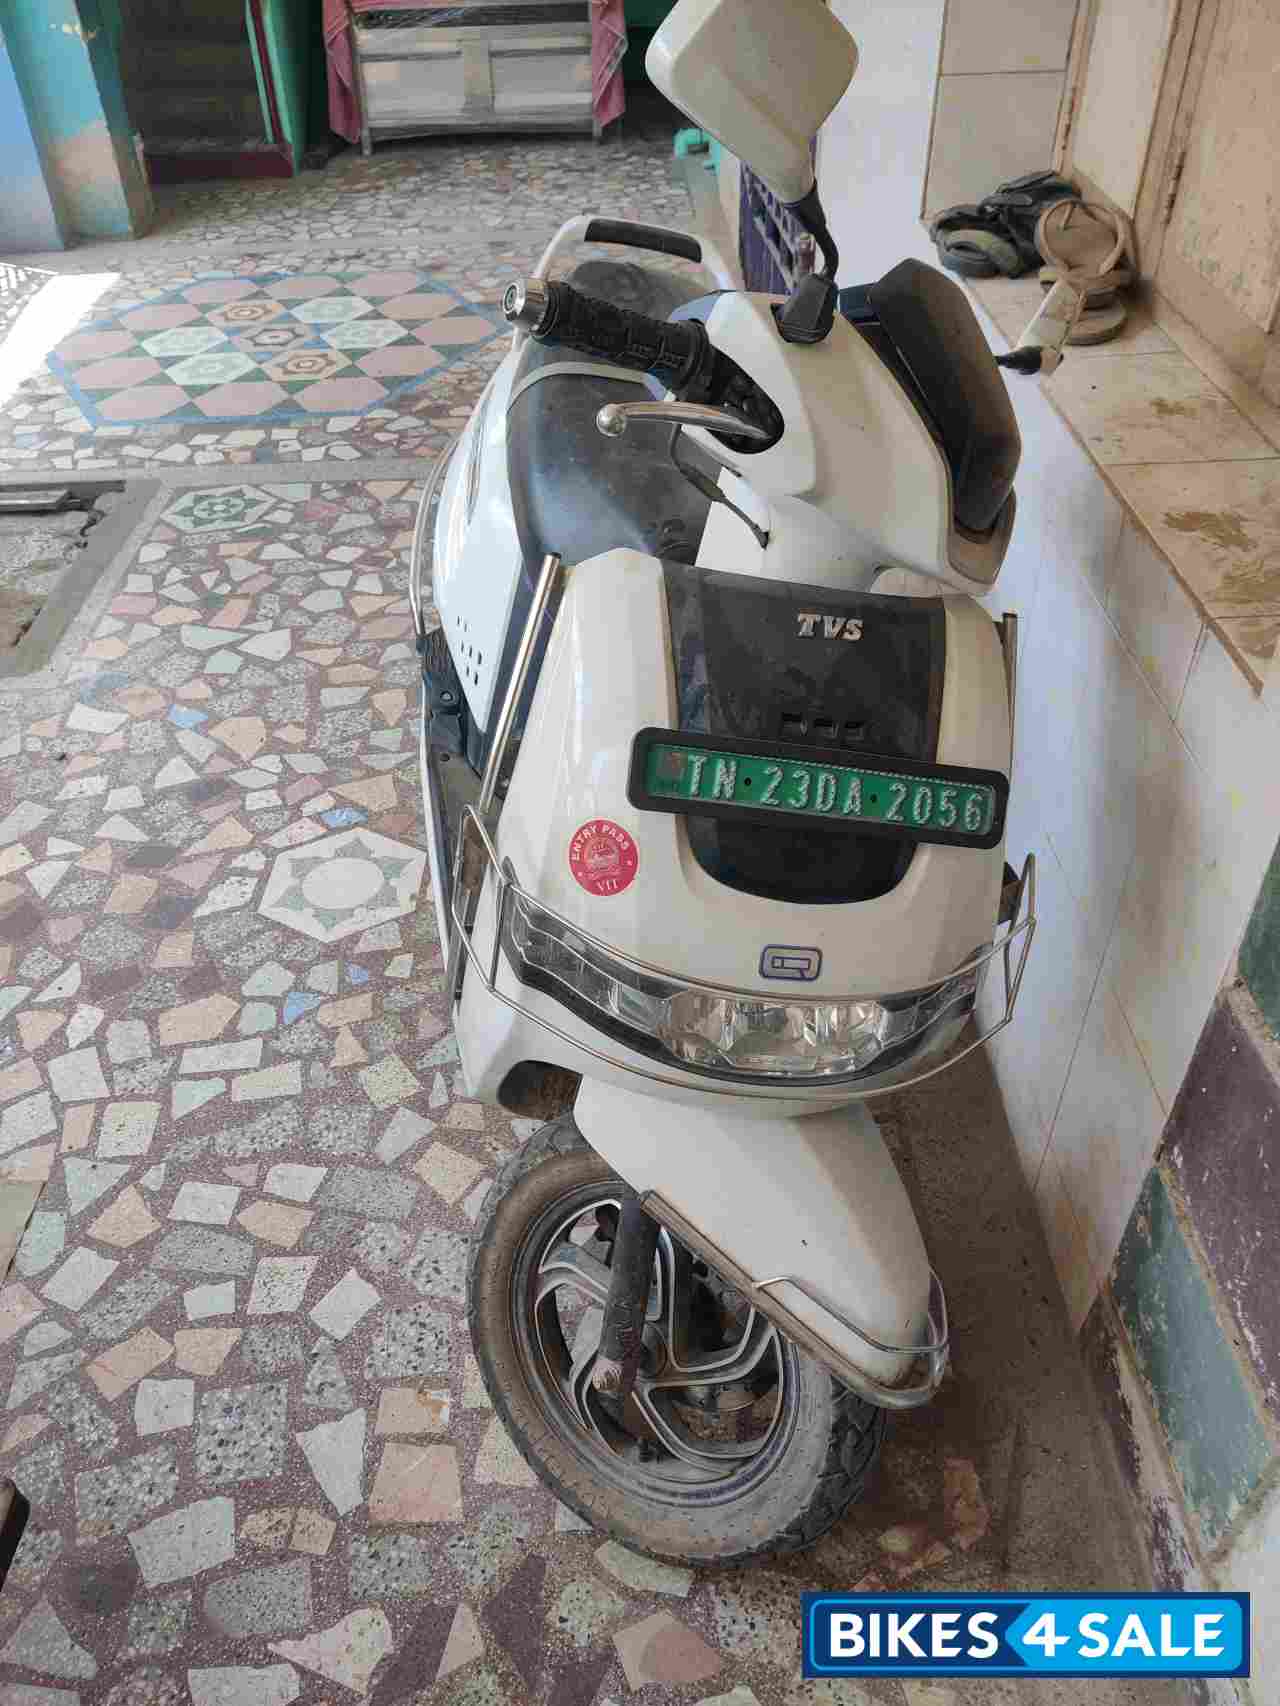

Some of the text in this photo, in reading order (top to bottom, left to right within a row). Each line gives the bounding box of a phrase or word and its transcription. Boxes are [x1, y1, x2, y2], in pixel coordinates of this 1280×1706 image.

[797, 612, 864, 640] TVS
[689, 754, 737, 799] TN
[884, 782, 983, 832] 2056
